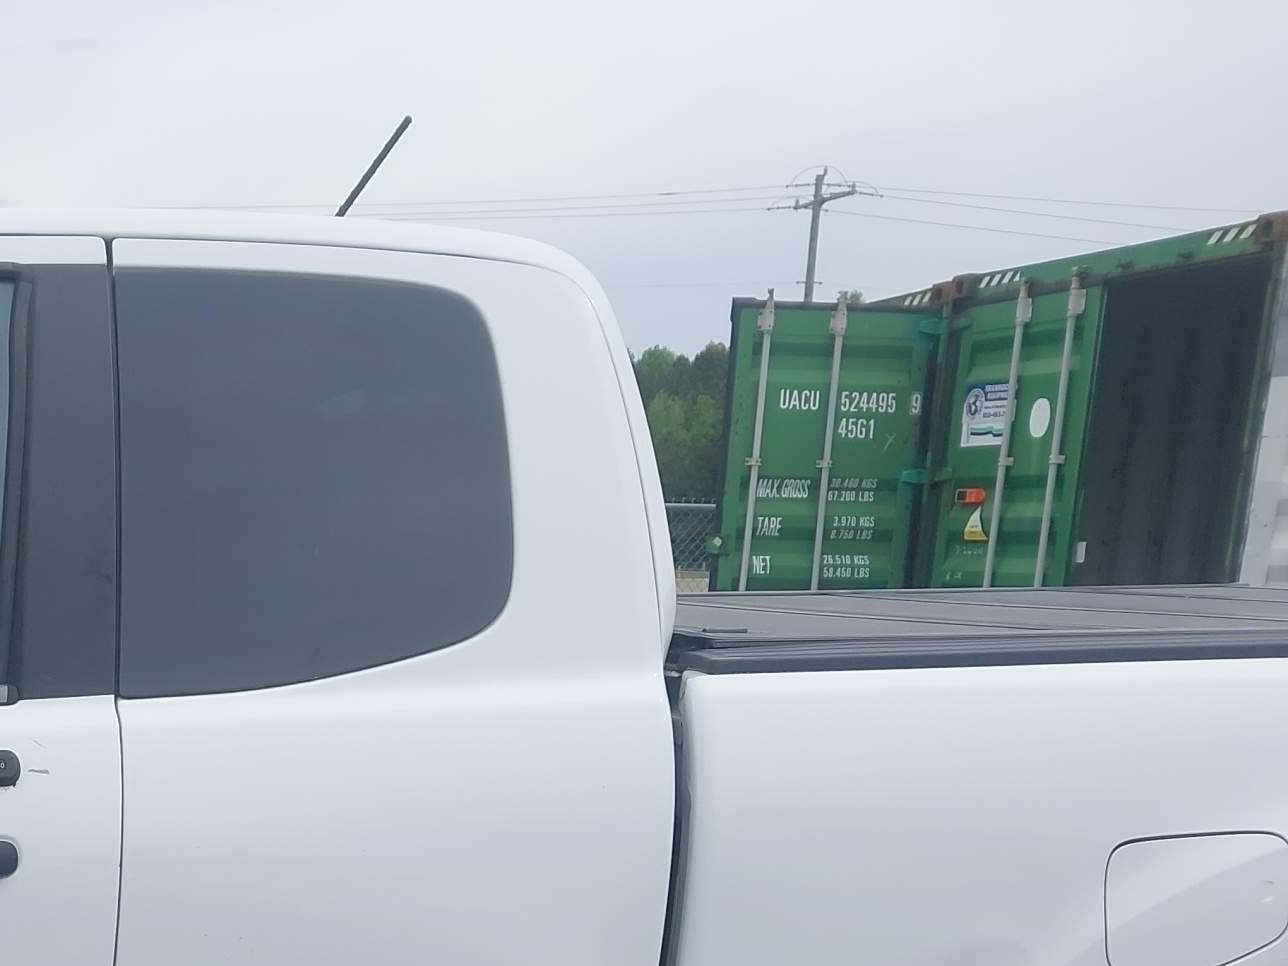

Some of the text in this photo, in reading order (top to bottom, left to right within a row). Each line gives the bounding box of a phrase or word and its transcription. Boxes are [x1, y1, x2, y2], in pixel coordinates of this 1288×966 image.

[779, 389, 921, 413] UACU 524495 9
[838, 418, 875, 439] 45G1
[858, 491, 875, 502] LBS
[756, 517, 783, 536] TARE
[859, 516, 875, 527] KGS
[856, 530, 873, 540] LBS
[752, 555, 771, 574] NET
[853, 555, 870, 565] KGS
[854, 567, 870, 578] LBS
